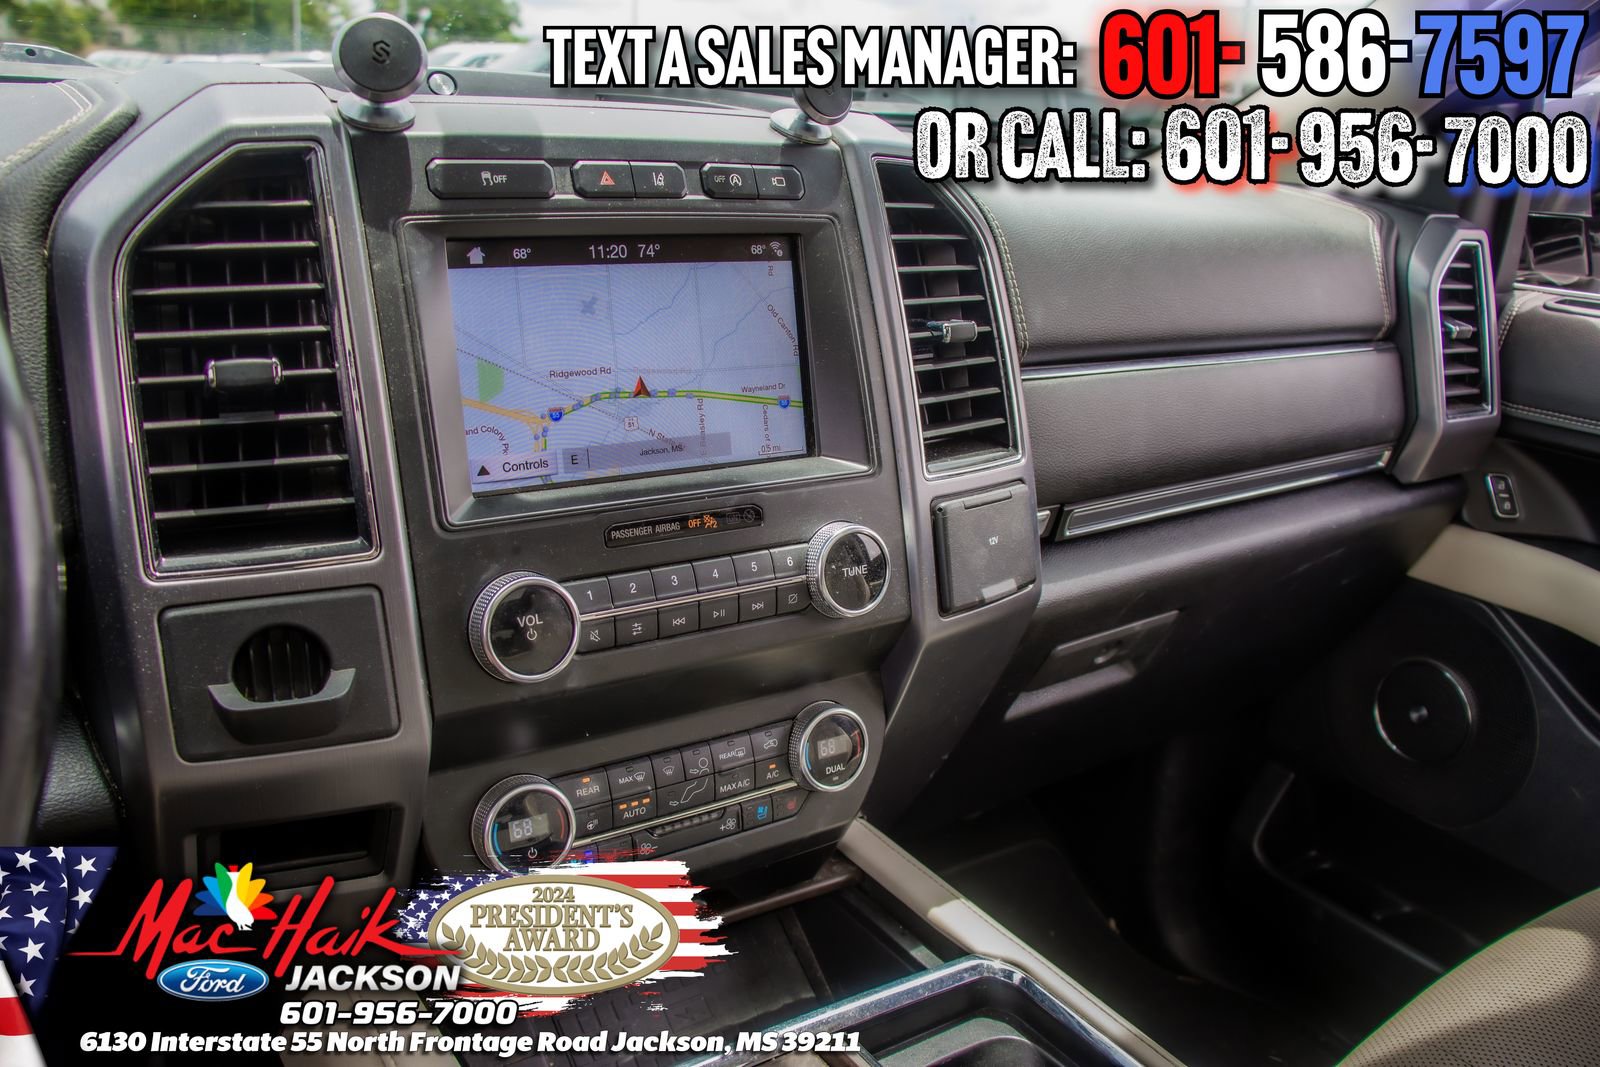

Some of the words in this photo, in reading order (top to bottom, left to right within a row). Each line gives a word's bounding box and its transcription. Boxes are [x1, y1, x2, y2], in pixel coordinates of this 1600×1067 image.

[492, 174, 507, 184] OFF
[714, 175, 726, 183] OFF
[589, 244, 627, 260] 11:20
[767, 304, 779, 318] Old
[777, 317, 796, 343] Canton
[793, 344, 799, 357] Rd
[549, 367, 598, 379] Ridgewood
[600, 367, 612, 375] Rd
[480, 425, 506, 442] Colony
[571, 454, 579, 465] E
[502, 458, 549, 473] Controls
[611, 525, 653, 540] PASSENGER
[655, 522, 681, 533] AIRBAG
[688, 519, 702, 529] OFF
[751, 562, 758, 572] 5
[787, 557, 794, 567] 6
[712, 569, 719, 579] 4
[842, 564, 868, 578] TUNE
[671, 575, 679, 586] 3
[629, 583, 637, 594] 2
[587, 590, 593, 600] 1
[517, 615, 543, 628] VOL
[820, 739, 836, 757] 68
[719, 751, 735, 761] REAR
[766, 769, 780, 780] A/C
[825, 763, 846, 775] DUAL
[618, 775, 633, 785] MAX
[576, 785, 600, 797] REAR
[719, 783, 737, 793] MAX
[623, 807, 646, 819] AUTO
[513, 818, 533, 839] 68
